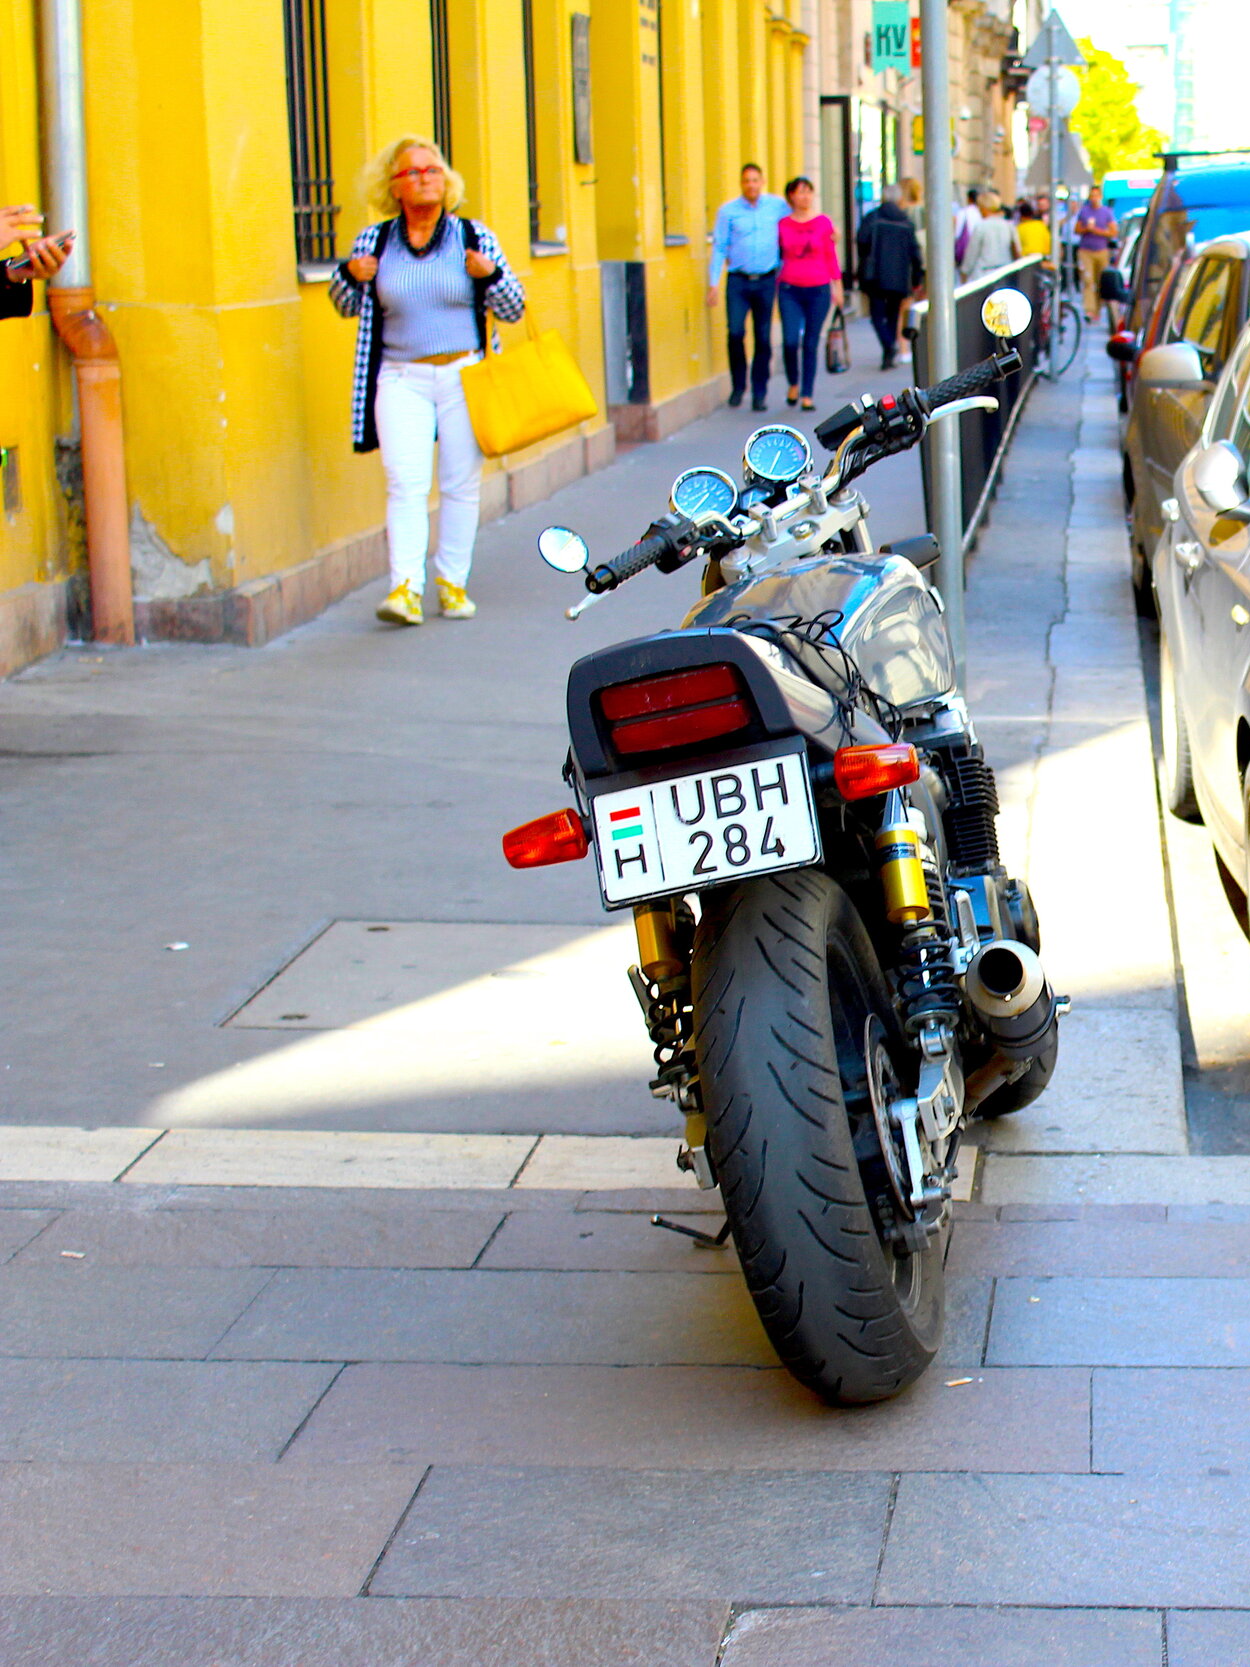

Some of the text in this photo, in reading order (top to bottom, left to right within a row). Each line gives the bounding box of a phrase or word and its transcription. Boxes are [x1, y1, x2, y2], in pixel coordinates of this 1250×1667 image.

[876, 23, 907, 57] KV
[670, 763, 788, 825] UBH
[614, 843, 648, 878] H
[689, 816, 785, 875] 284
